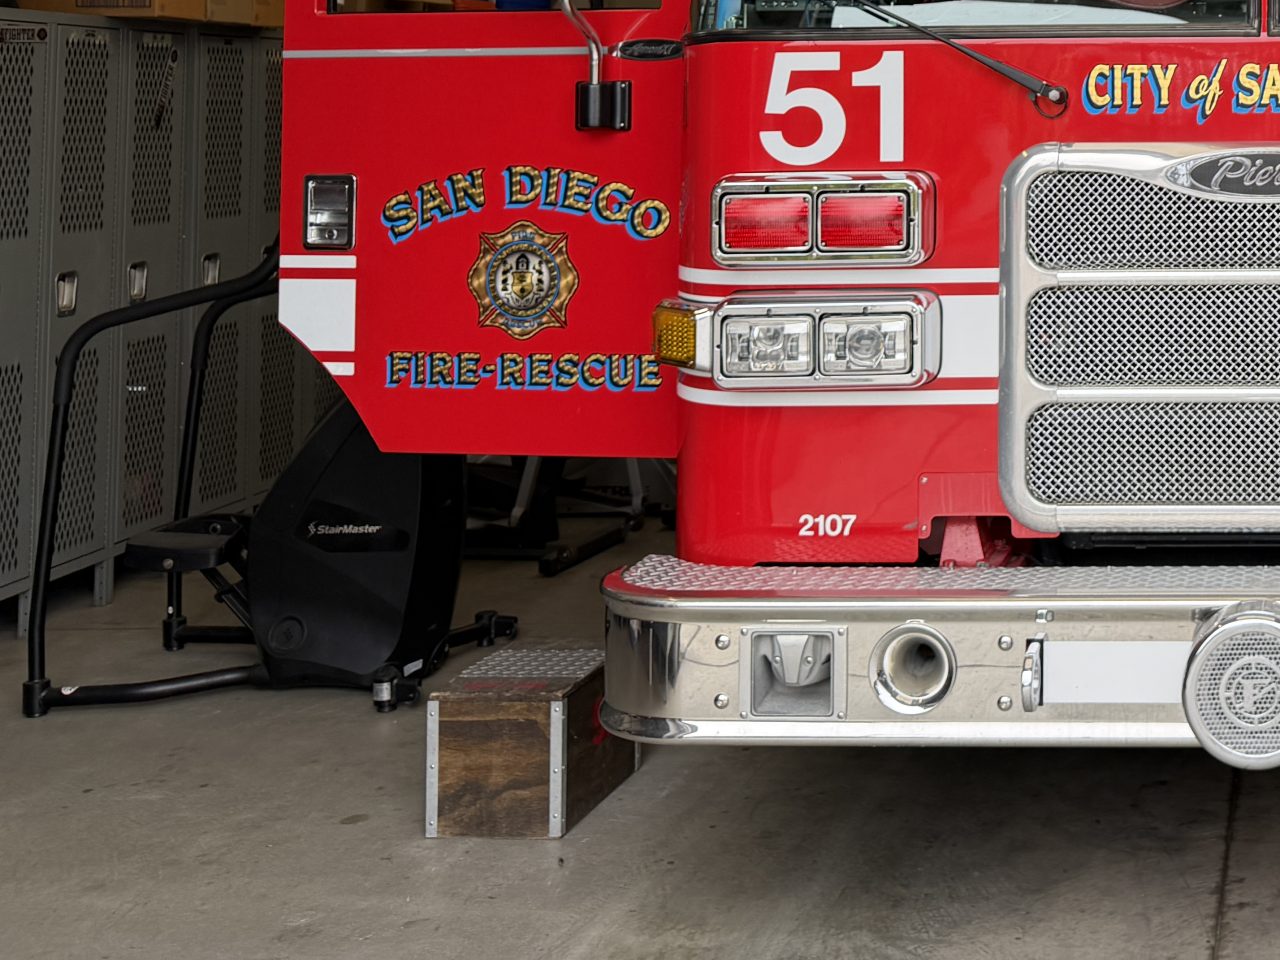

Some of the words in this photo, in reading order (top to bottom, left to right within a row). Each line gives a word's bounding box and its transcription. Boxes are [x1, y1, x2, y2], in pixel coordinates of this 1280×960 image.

[758, 50, 905, 167] 51
[1082, 62, 1178, 114] CITY
[1181, 58, 1228, 125] of
[380, 167, 485, 244] SAN
[502, 164, 672, 241] DIEGO
[385, 350, 664, 392] FIRE-RESCUE
[317, 524, 382, 535] StairMaster
[798, 513, 857, 537] 2107
